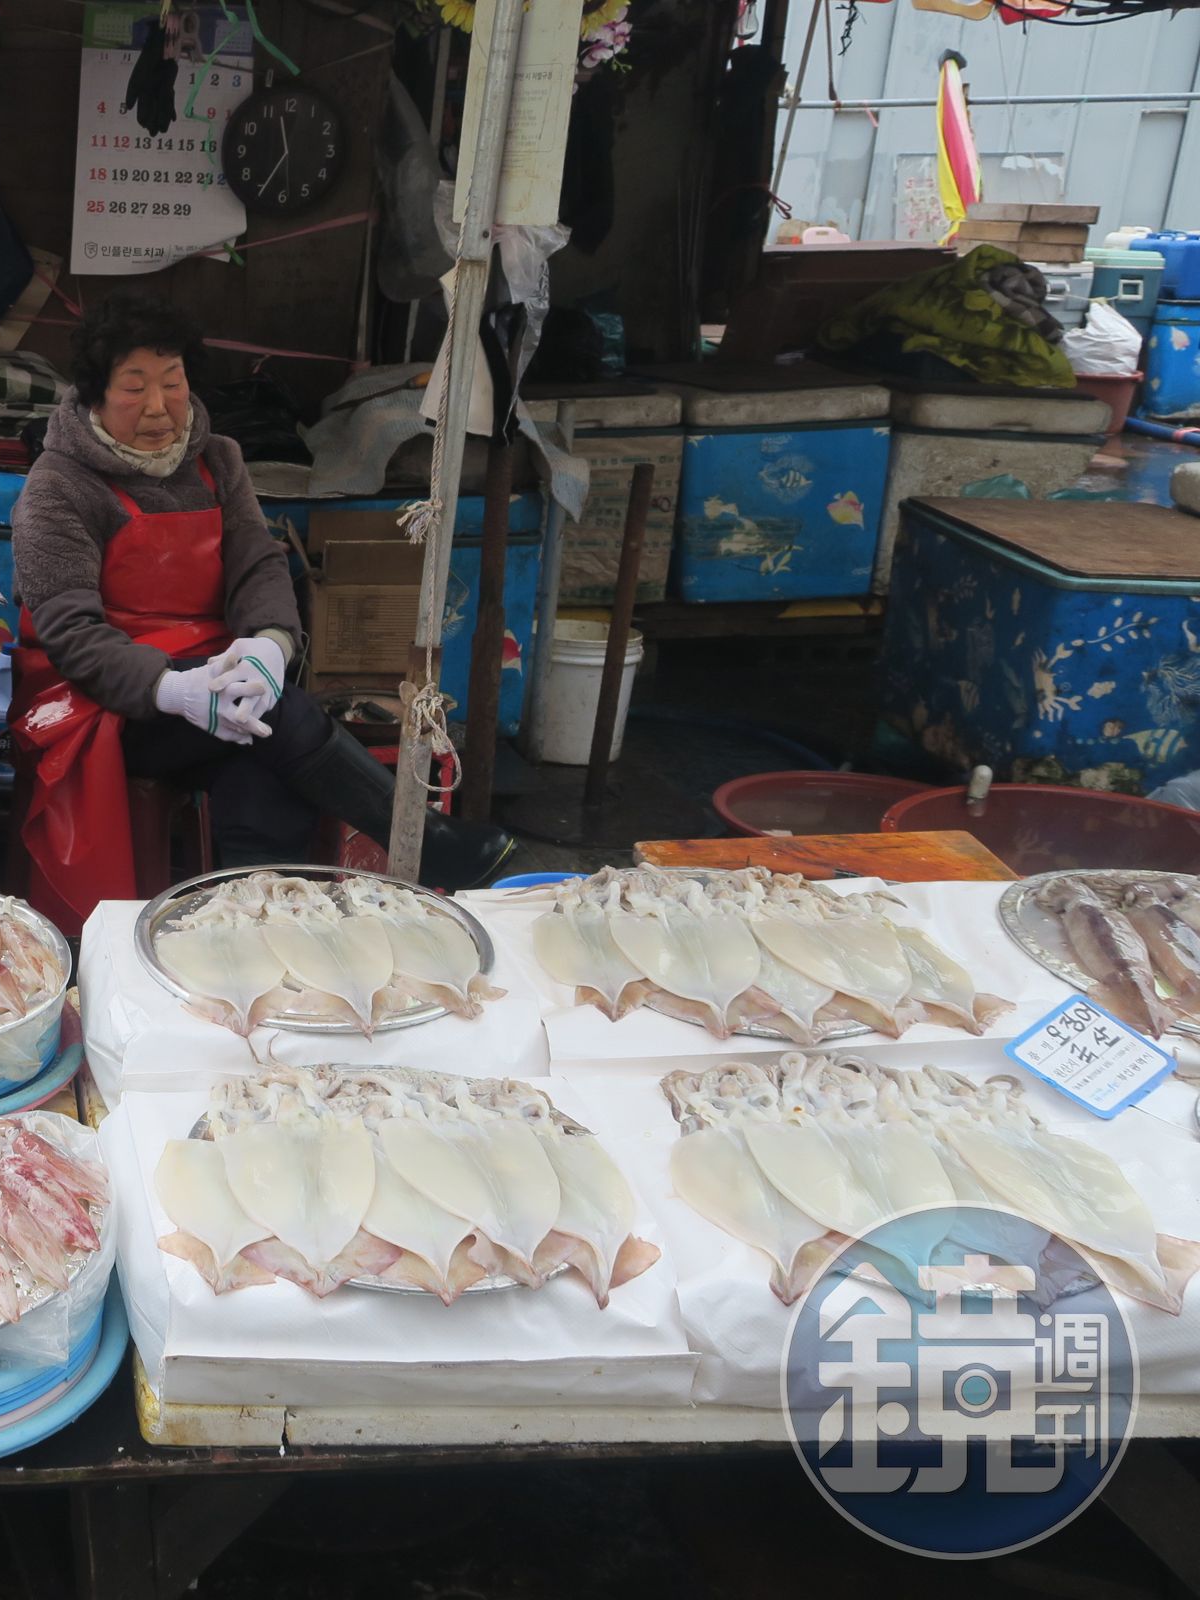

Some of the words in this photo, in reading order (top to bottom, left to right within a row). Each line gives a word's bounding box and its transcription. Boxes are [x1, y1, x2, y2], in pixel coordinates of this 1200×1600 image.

[188, 72, 196, 84] 1
[210, 74, 220, 86] 2
[232, 75, 241, 87] 3
[97, 102, 106, 113] 4
[119, 102, 128, 114] 5
[207, 107, 216, 119] 9
[263, 105, 274, 118] 11
[285, 98, 297, 112] 12
[311, 104, 315, 118] 1
[244, 121, 257, 135] 10
[322, 121, 331, 135] 2
[91, 135, 107, 147] 11
[113, 136, 130, 148] 12
[135, 137, 151, 149] 13
[156, 138, 173, 150] 14
[178, 139, 194, 151] 15
[200, 140, 217, 153] 16
[326, 144, 335, 158] 3
[236, 144, 247, 159] 9
[89, 168, 107, 180] 18
[111, 169, 128, 181] 19
[132, 169, 150, 182] 20
[153, 170, 170, 183] 21
[175, 171, 193, 184] 22
[196, 172, 213, 185] 23
[217, 173, 226, 185] 2
[241, 167, 251, 181] 8
[318, 168, 327, 180] 4
[278, 189, 287, 203] 6
[300, 183, 310, 197] 5
[86, 200, 105, 213] 25
[109, 201, 127, 214] 26
[130, 202, 148, 214] 27
[152, 203, 170, 215] 28
[173, 204, 191, 216] 29
[1046, 1001, 1102, 1046] 오징어
